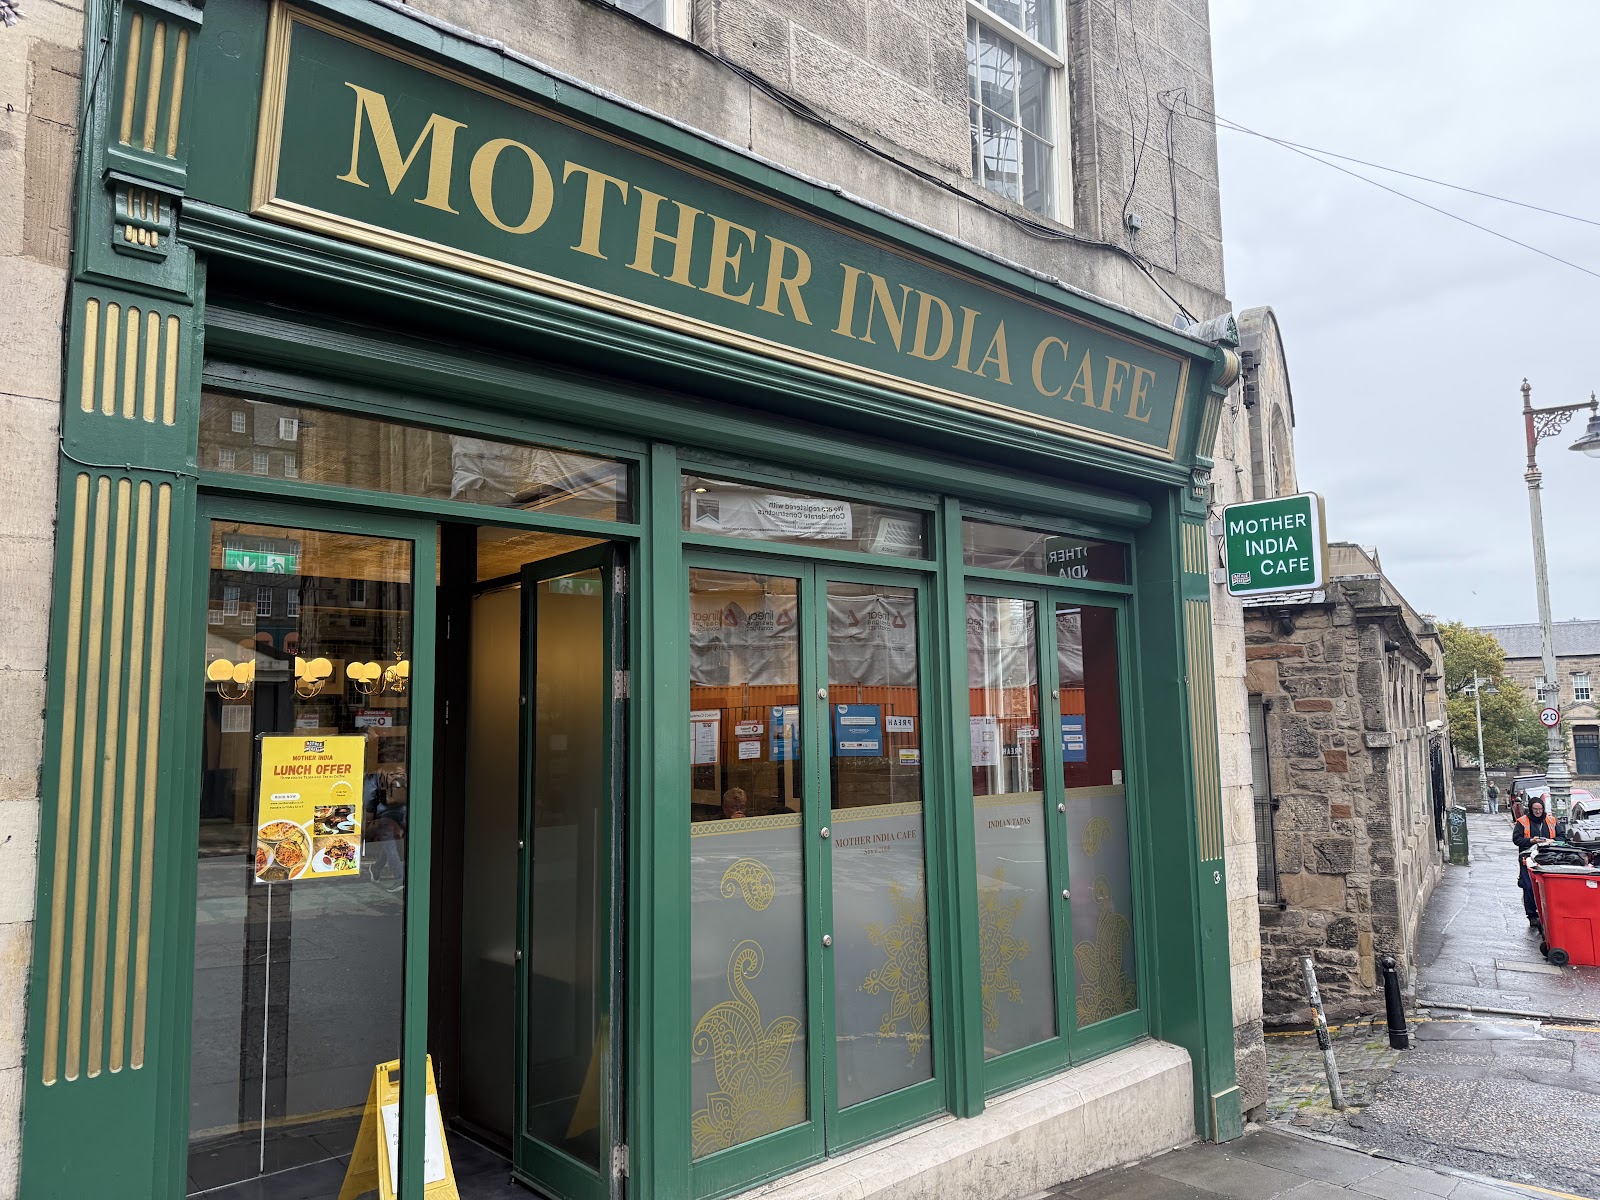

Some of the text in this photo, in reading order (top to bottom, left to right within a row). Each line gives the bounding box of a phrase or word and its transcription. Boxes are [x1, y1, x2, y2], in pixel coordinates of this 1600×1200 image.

[337, 82, 1157, 423] MOTHER INDIA CAFE
[1230, 513, 1306, 536] MOTHER
[1245, 536, 1298, 557] INDIA
[1260, 557, 1310, 575] CAFE
[1542, 712, 1557, 722] 20
[273, 763, 352, 776] LUNCH OFFER
[988, 816, 1031, 829] INDIAN TAPAS
[835, 829, 917, 848] MOTHER INDIA CAFE
